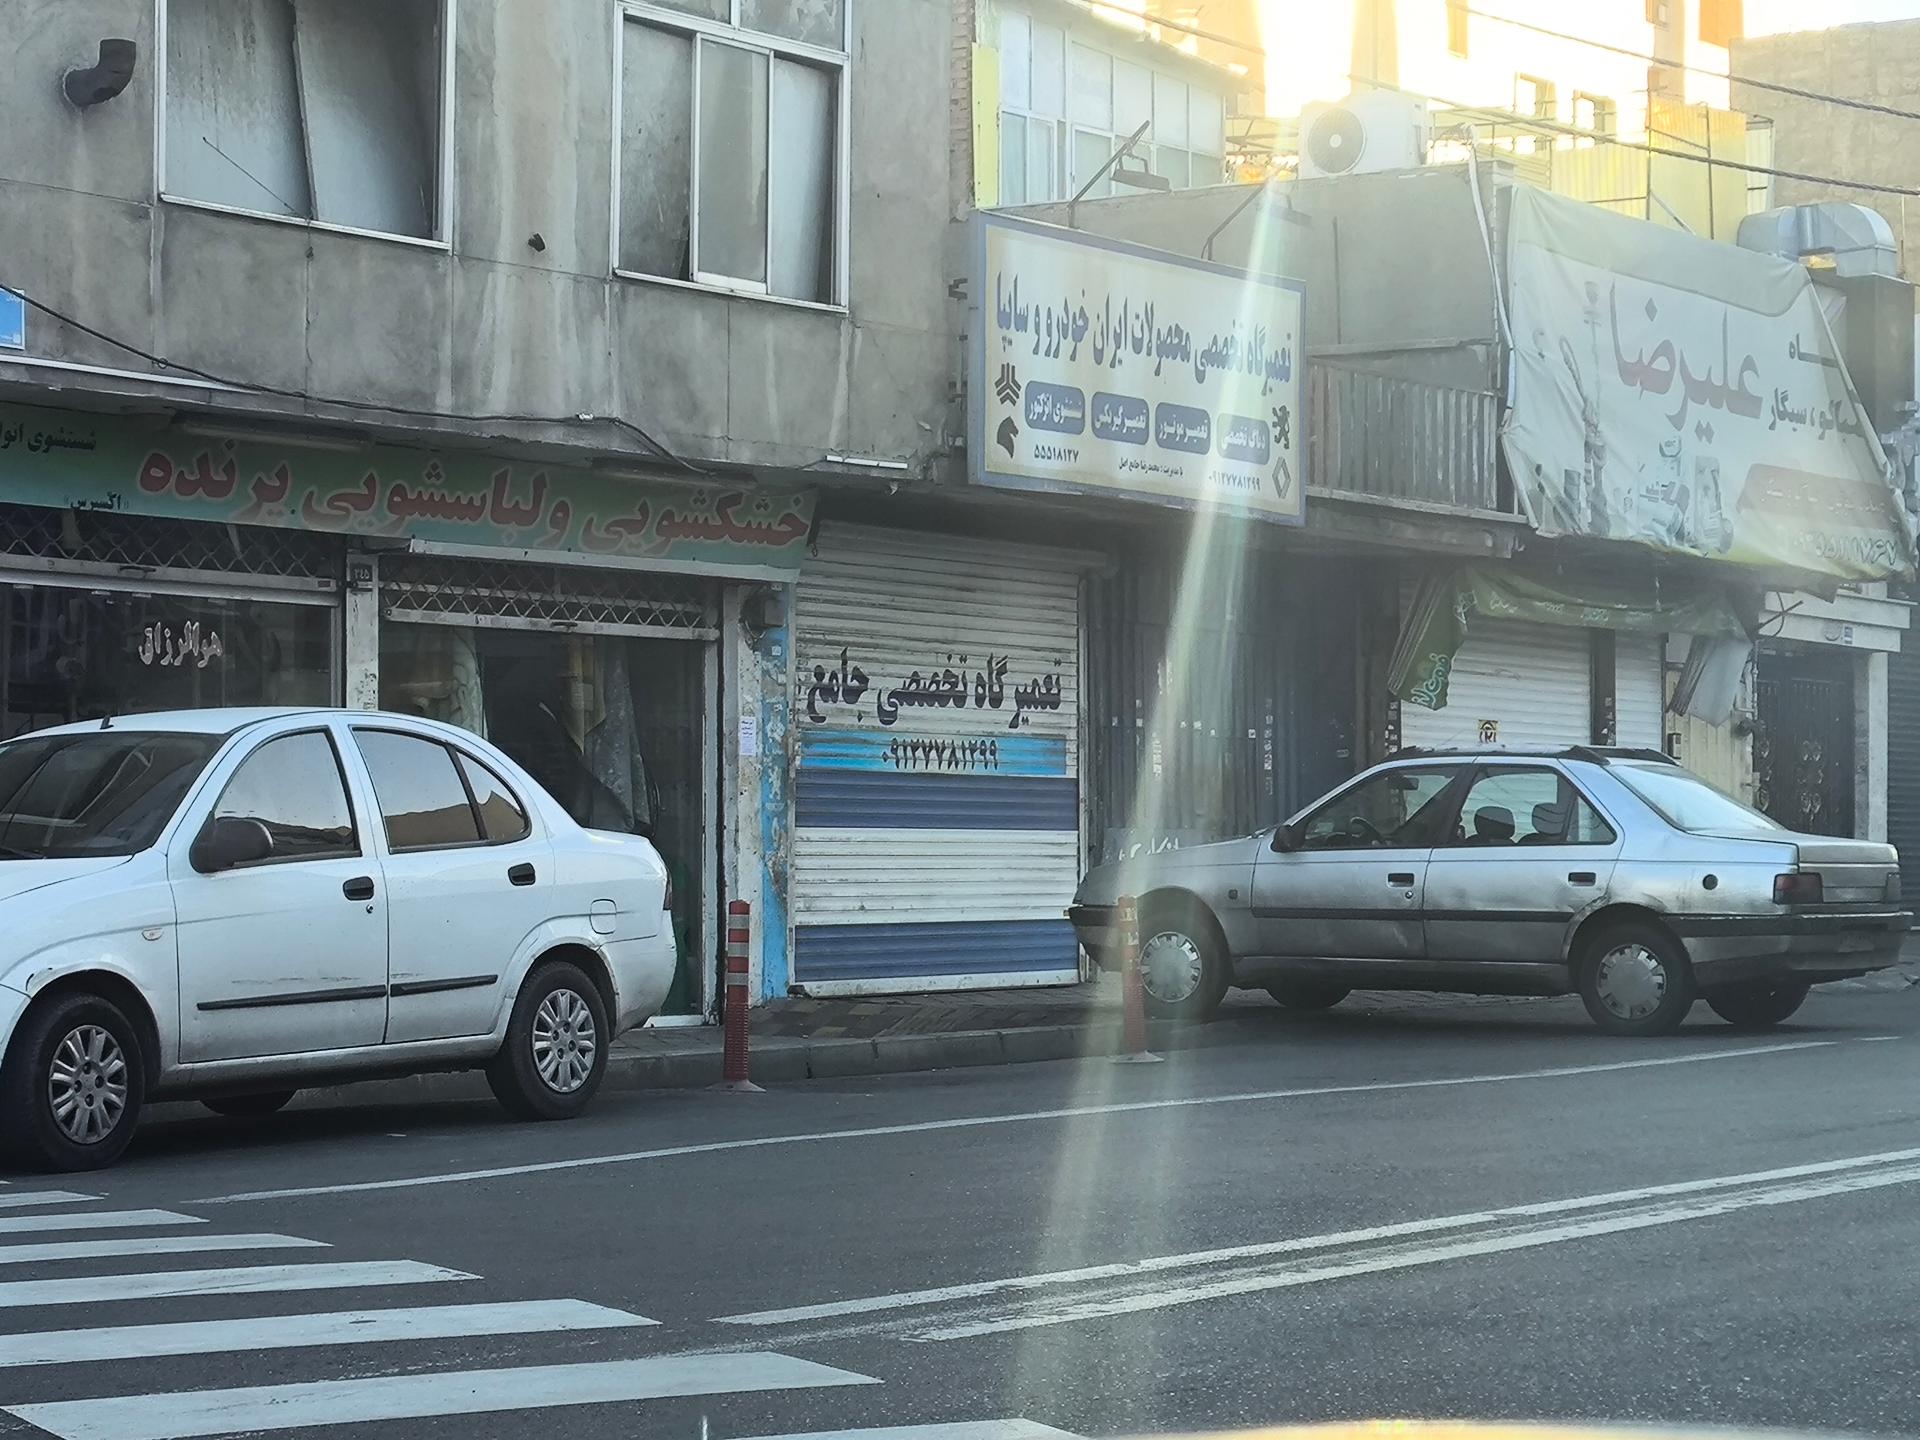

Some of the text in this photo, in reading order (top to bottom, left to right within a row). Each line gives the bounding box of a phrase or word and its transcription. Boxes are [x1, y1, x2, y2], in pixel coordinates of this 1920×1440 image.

[996, 271, 1029, 353] سایپا
[1031, 301, 1042, 357] و
[1045, 288, 1089, 362] خودرو
[1092, 292, 1128, 369] ایران
[1131, 301, 1192, 377] محصولات
[1195, 318, 1246, 384] تخصصی
[1609, 279, 1763, 444] علیرضا
[27, 425, 97, 453] شستشوی
[1122, 410, 1148, 436] تعمیر
[1184, 418, 1209, 443] تعمیر
[300, 461, 549, 541] لباسشویی
[536, 496, 572, 549] و
[579, 488, 811, 556] خشکشویی
[807, 646, 870, 724] جامع
[876, 653, 968, 726] تخصصی
[881, 736, 999, 770] ۰۹۱۲۷۷۸۱۲۹۹
